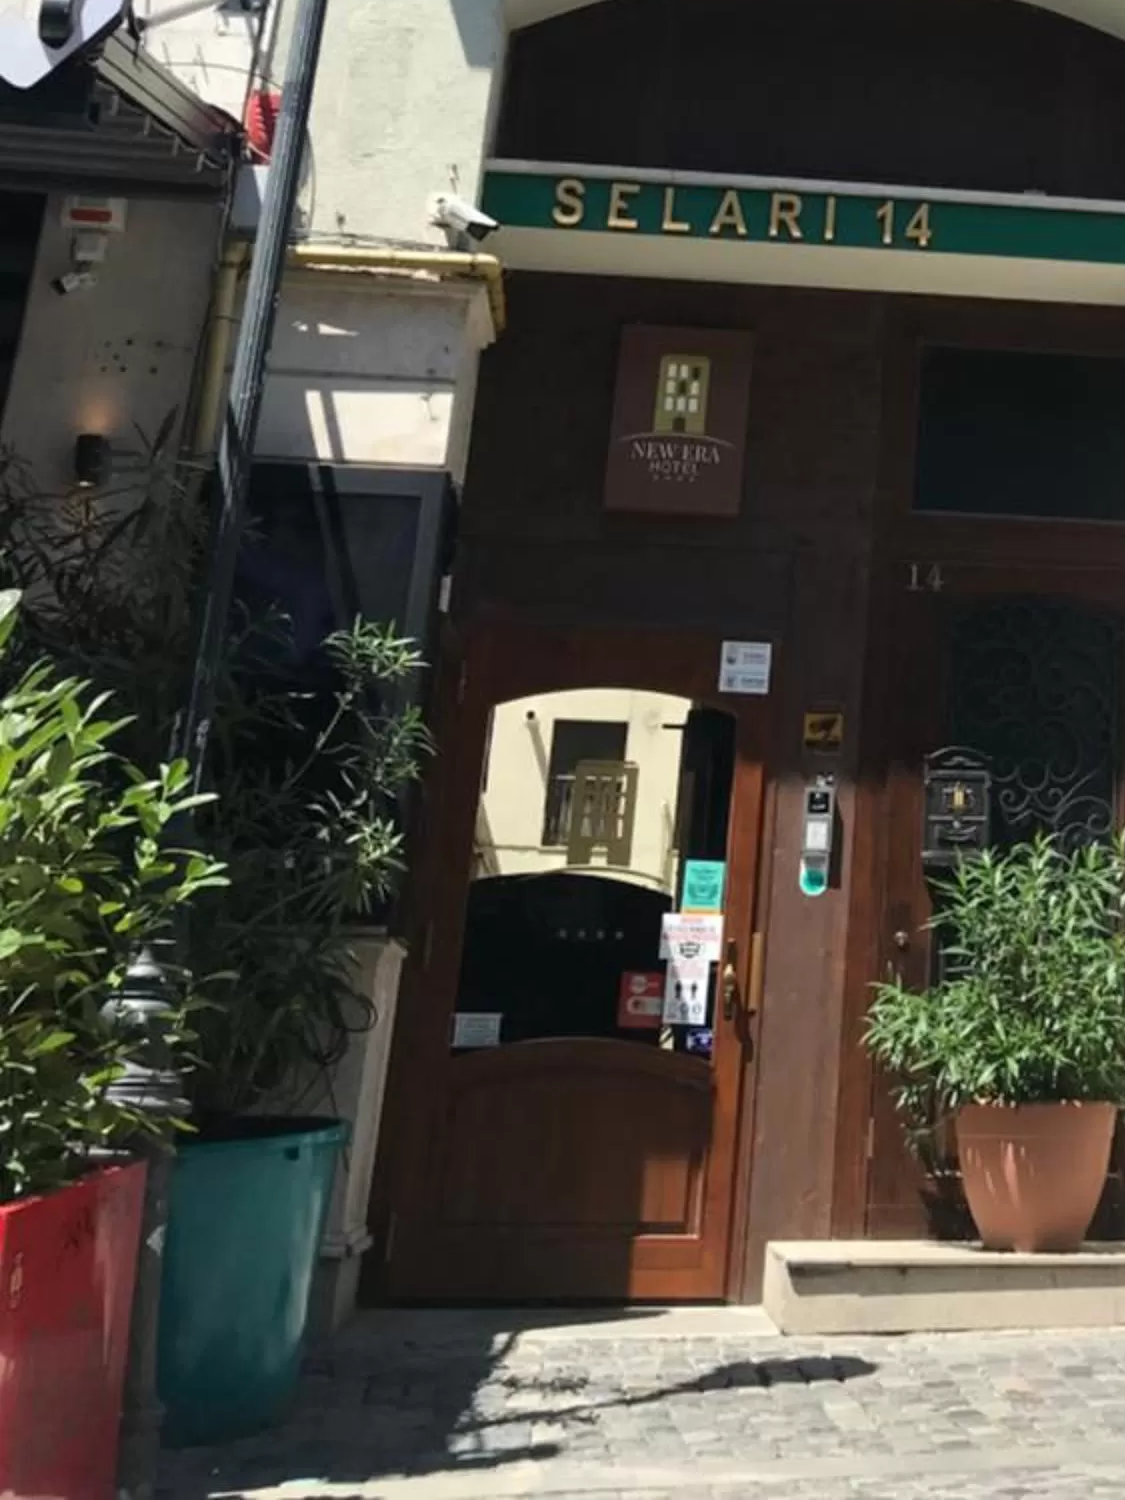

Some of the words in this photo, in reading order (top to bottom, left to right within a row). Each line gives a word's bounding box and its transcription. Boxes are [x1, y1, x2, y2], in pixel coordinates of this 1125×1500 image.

[551, 179, 837, 241] SELARI
[875, 201, 932, 247] 14
[629, 441, 678, 460] NEW
[681, 443, 720, 465] ERA
[648, 460, 698, 475] HOTEL
[905, 562, 944, 592] 14
